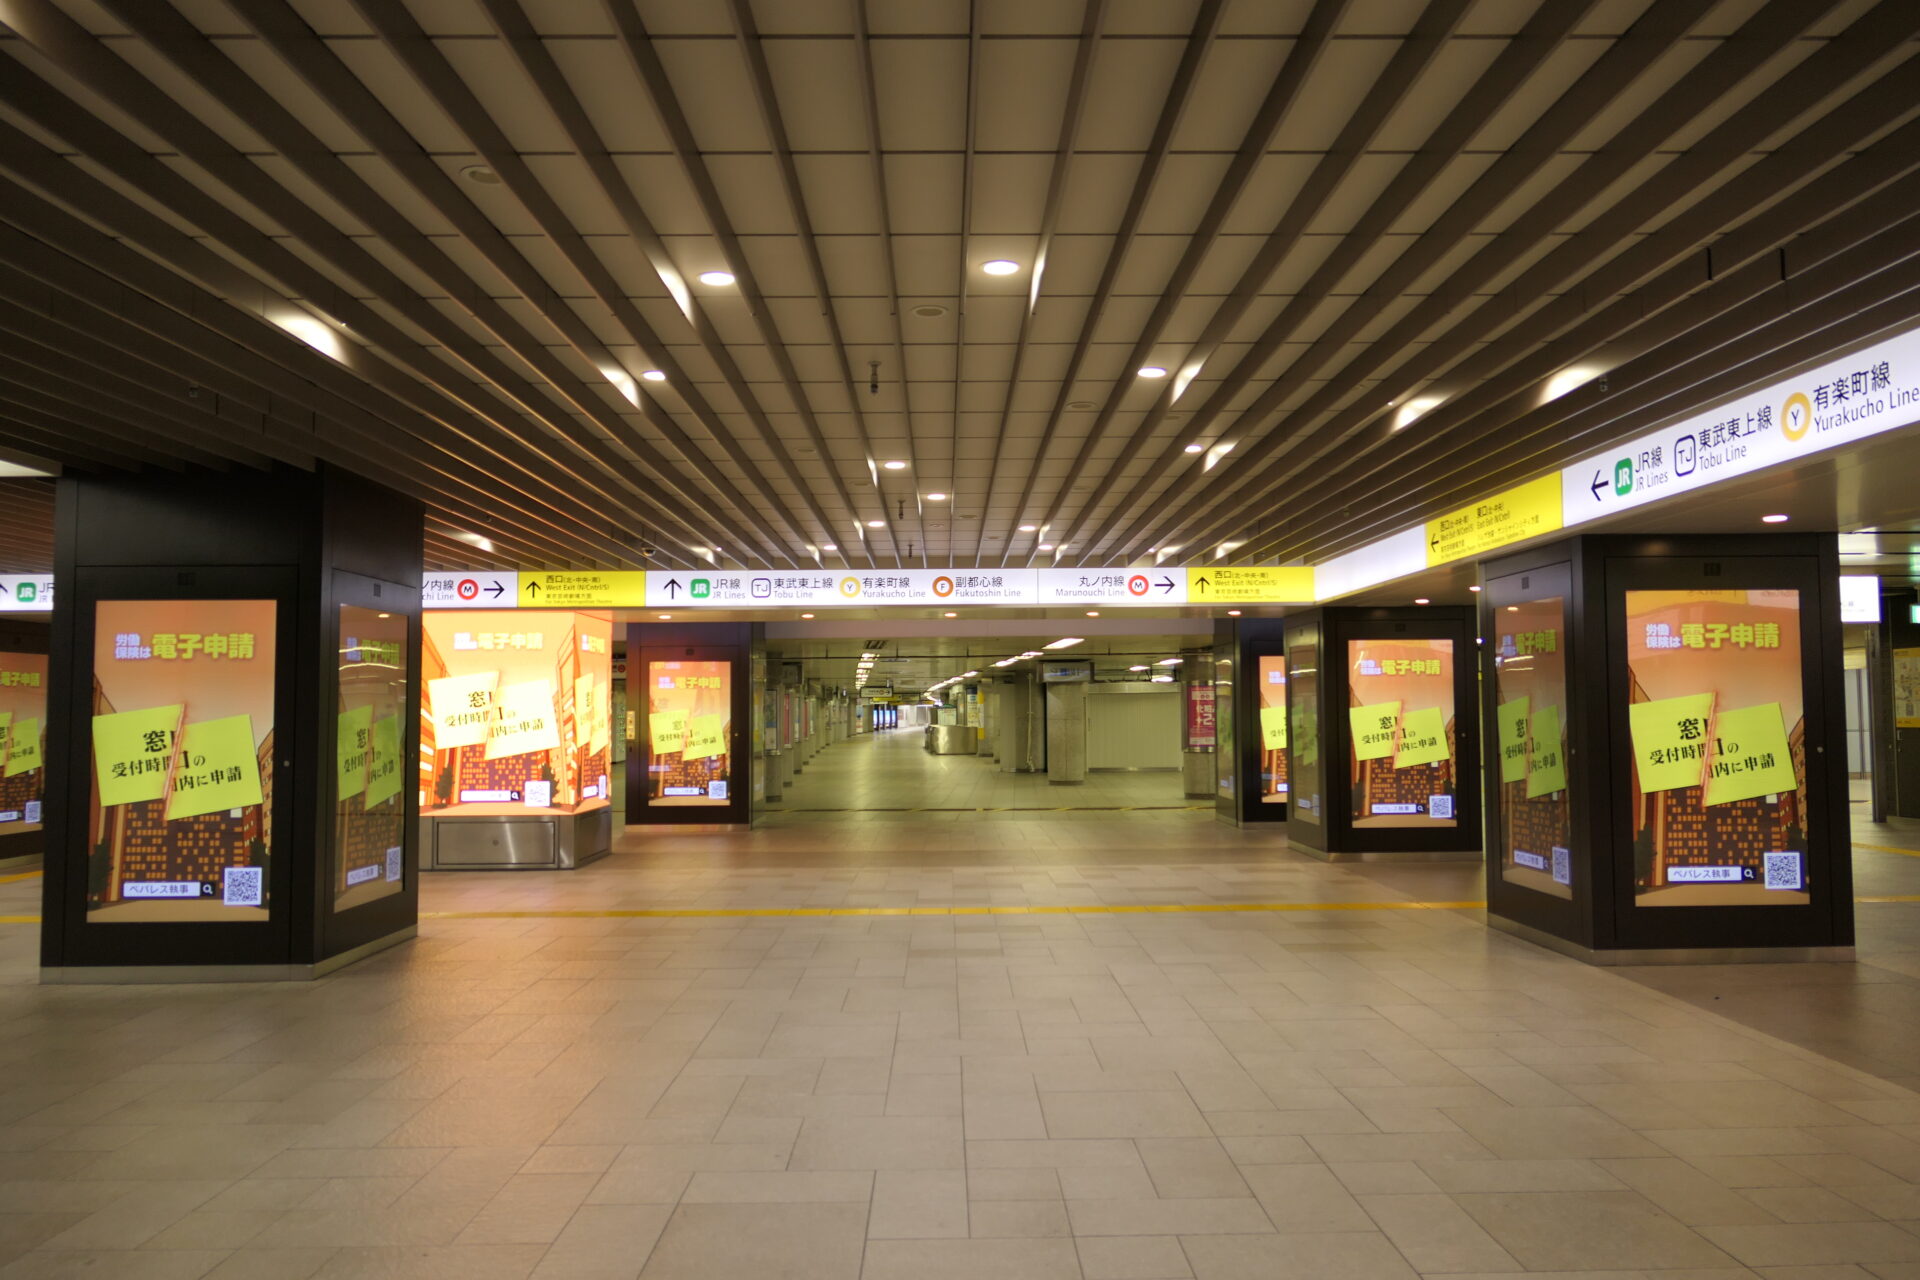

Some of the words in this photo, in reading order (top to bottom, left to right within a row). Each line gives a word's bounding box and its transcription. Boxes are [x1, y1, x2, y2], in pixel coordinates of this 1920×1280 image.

[1813, 361, 1891, 412] 有楽町線
[1814, 398, 1884, 433] Yurakucho
[1889, 386, 1920, 412] Line
[1791, 409, 1800, 426] Y
[1699, 405, 1773, 452] 東武東上線
[1635, 446, 1663, 474] JR線
[1677, 446, 1694, 465] TJ
[1699, 452, 1723, 471] Tobu
[1725, 445, 1748, 465] Line
[1616, 467, 1631, 487] JR
[1635, 476, 1645, 491] JR
[1646, 471, 1668, 489] Lines
[712, 578, 741, 590] JR線
[773, 577, 834, 589] 東武東上線
[846, 583, 853, 592] Y
[862, 577, 911, 588] 有楽町線
[940, 583, 946, 592] F
[955, 576, 1004, 588] 副都心線
[1079, 576, 1125, 588] 丸ノ内線
[1134, 581, 1143, 589] M
[20, 587, 35, 599] JR
[692, 582, 708, 595] JR
[712, 591, 723, 599] JR
[724, 590, 746, 599] Lines
[755, 584, 768, 593] TJ
[773, 590, 795, 599] Tobu
[796, 590, 813, 599] Line
[862, 589, 906, 599] Yurakucho
[908, 589, 926, 598] Line
[955, 588, 1002, 597] Fukutoshin
[1004, 588, 1021, 597] Line
[1055, 588, 1106, 597] Marunouchi
[1107, 588, 1125, 597] Line
[437, 592, 454, 600] Line
[477, 632, 544, 649] 電子申請
[1681, 623, 1780, 648] 電子申請
[152, 633, 255, 659] 電子申請
[1515, 629, 1557, 655] 電子申請
[1381, 659, 1441, 675] 電子申請
